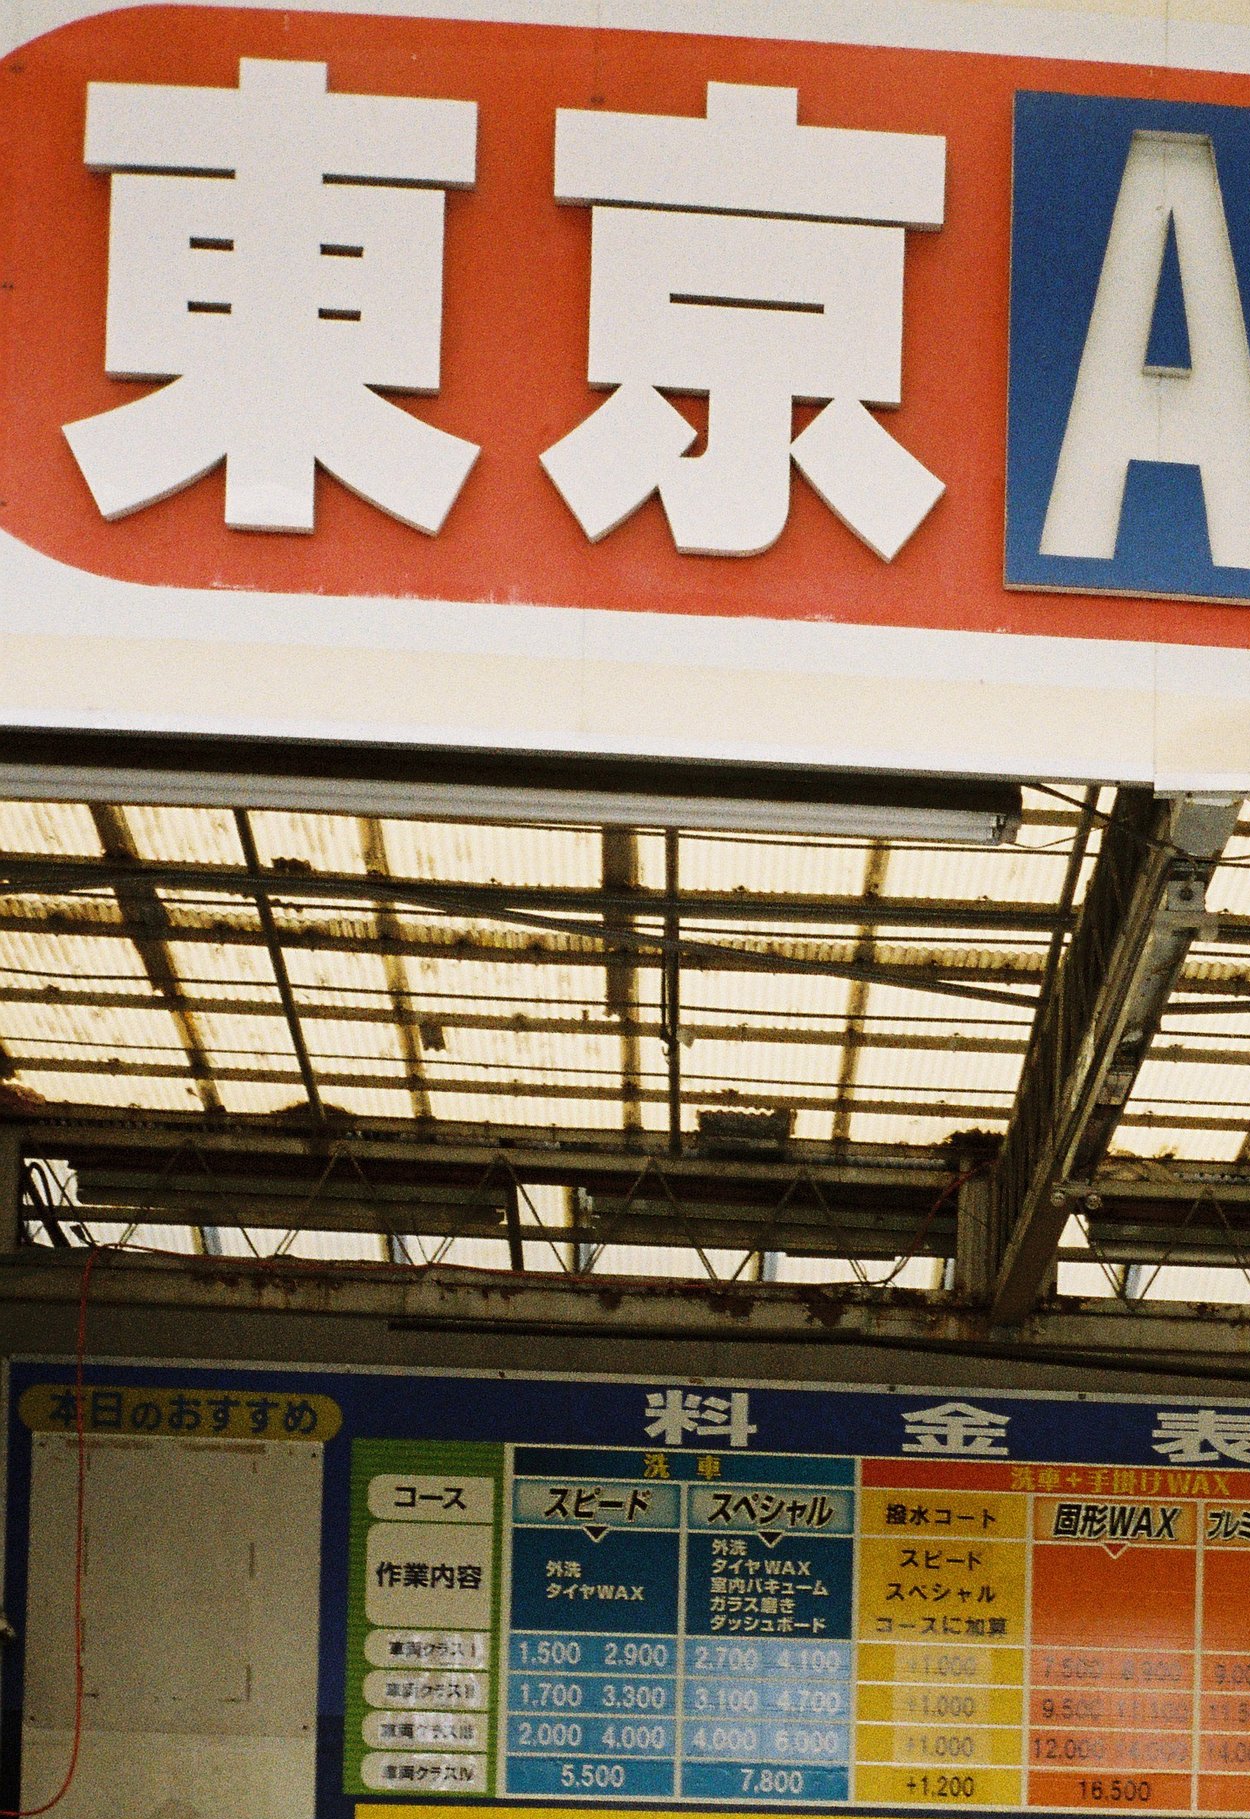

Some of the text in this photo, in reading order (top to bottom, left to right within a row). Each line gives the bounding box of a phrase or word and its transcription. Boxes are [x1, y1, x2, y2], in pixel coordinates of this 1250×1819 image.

[50, 1390, 320, 1434] 本日のおすすめ
[394, 1486, 467, 1511] コース
[544, 1487, 652, 1521] スピード
[708, 1492, 834, 1528] スペシャル
[885, 1503, 997, 1530] 撥水コート
[1053, 1501, 1181, 1541] 固形WAX
[712, 1539, 747, 1558] 外洗
[901, 1548, 983, 1571] スピード
[376, 1562, 483, 1591] 作業内容
[546, 1561, 582, 1579] 外洗
[546, 1582, 645, 1601] タイヤWAX
[710, 1577, 828, 1597] 室内バキューム
[885, 1580, 997, 1604] スペシャル
[710, 1615, 826, 1634] ダッシュボード
[875, 1614, 1008, 1636] コースに加算
